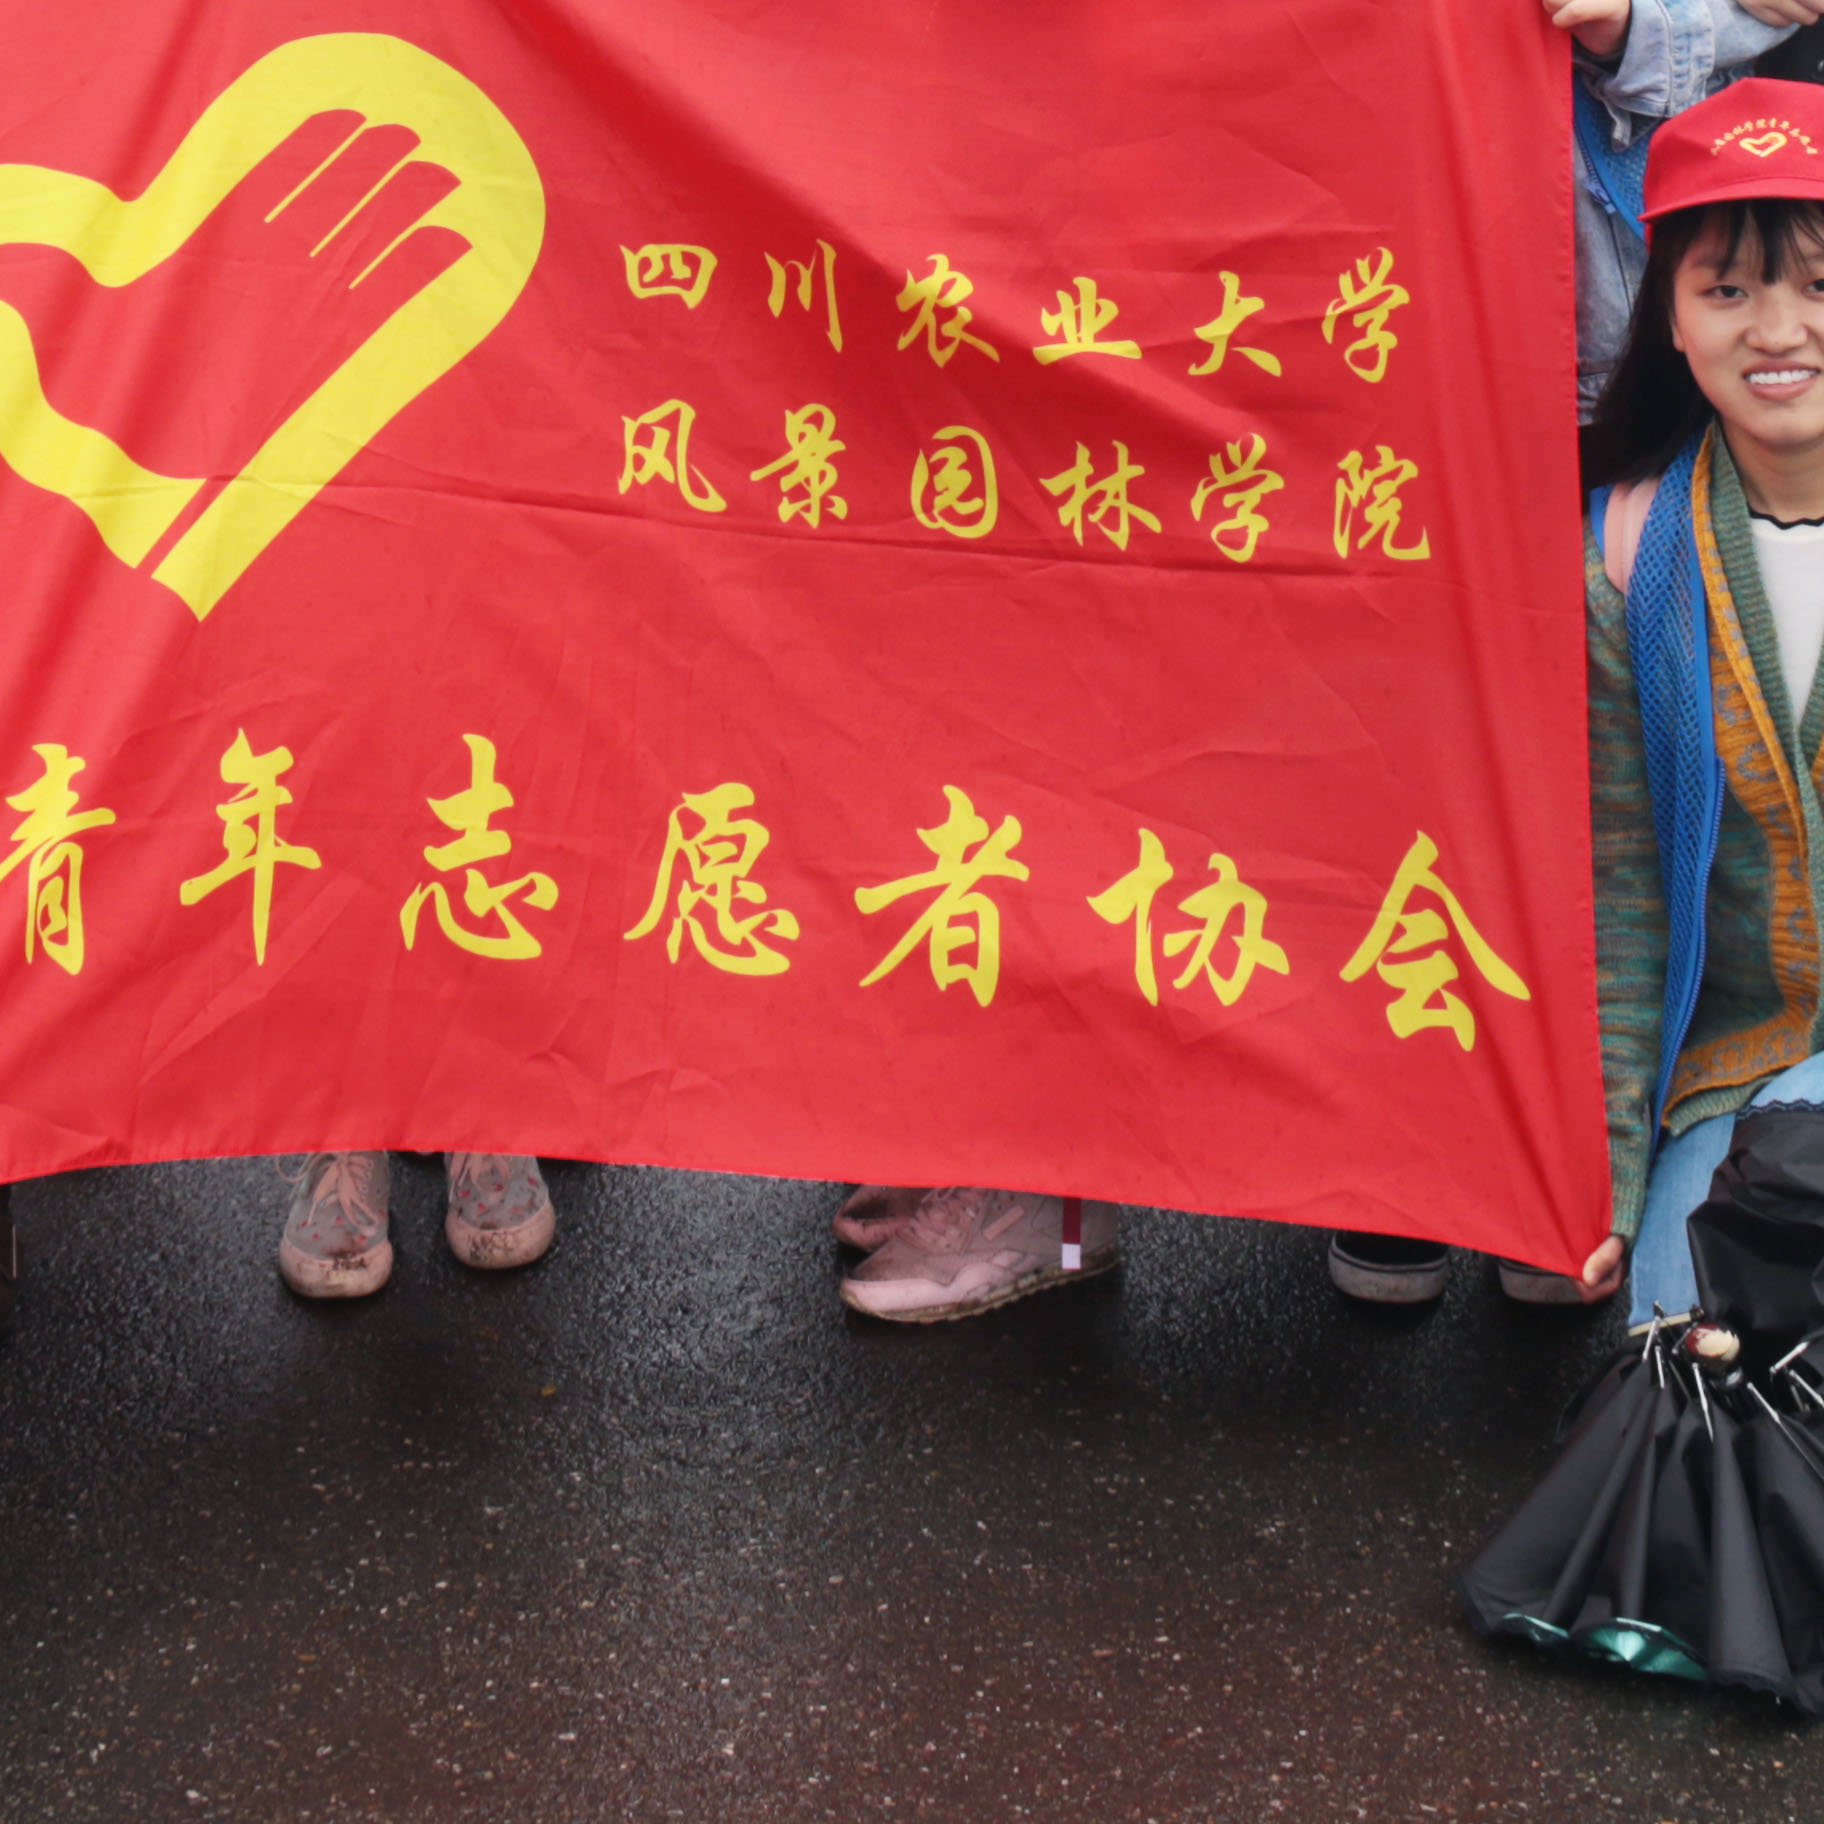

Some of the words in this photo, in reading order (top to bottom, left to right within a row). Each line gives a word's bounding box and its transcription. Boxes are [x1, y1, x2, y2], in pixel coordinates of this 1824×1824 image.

[618, 239, 1412, 384] 四川农业大学
[617, 398, 1433, 564] 风景园林学院
